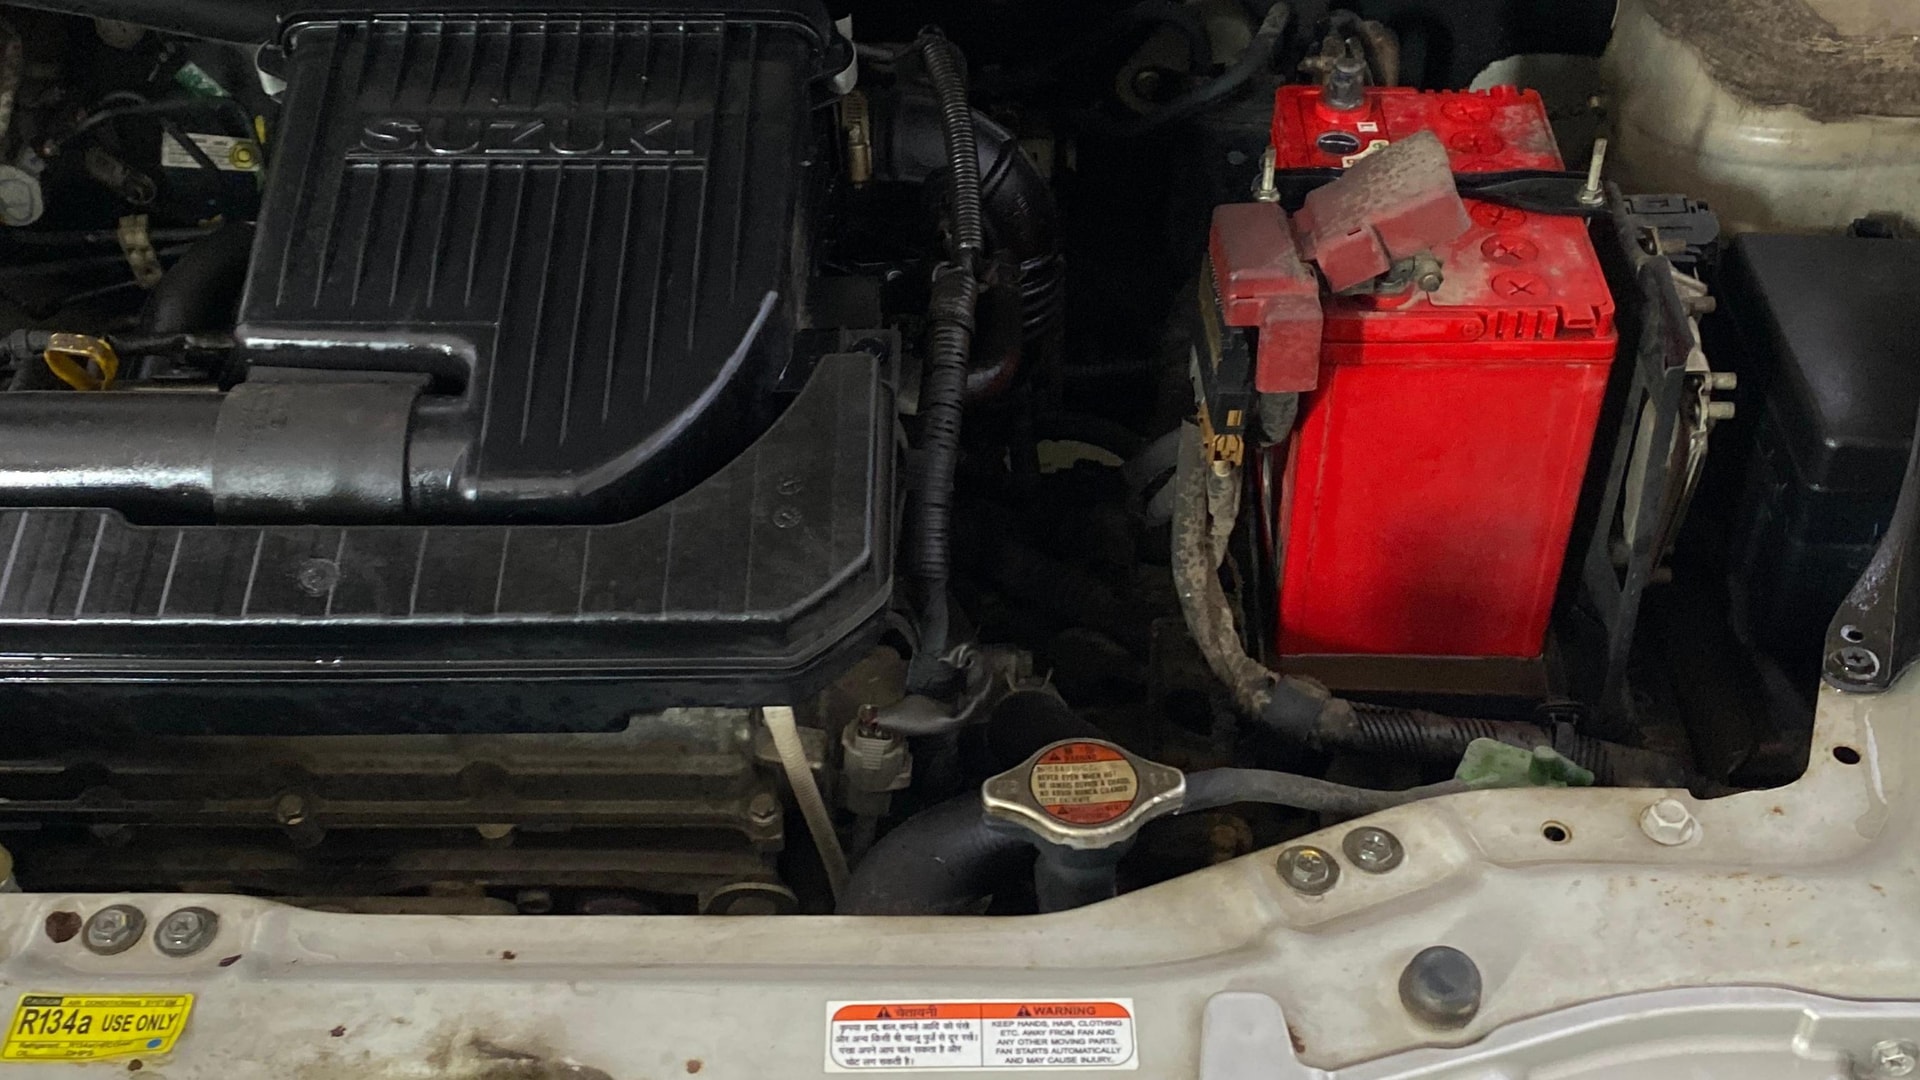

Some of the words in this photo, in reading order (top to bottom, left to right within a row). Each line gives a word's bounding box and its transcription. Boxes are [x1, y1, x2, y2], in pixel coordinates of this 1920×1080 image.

[360, 118, 695, 154] SUZUKI
[1033, 1006, 1097, 1016] WARNING
[17, 1009, 93, 1035] R134a
[102, 1014, 135, 1032] USE
[136, 1013, 179, 1032] ONLY
[1017, 1020, 1050, 1028] HANDS,
[1000, 1029, 1019, 1037] ETC.
[995, 1047, 1013, 1055] FAN
[1015, 1047, 1049, 1055] STARTS
[1051, 1047, 1122, 1055] AUTOMATICALLY
[1047, 1056, 1078, 1064] CAUSE
